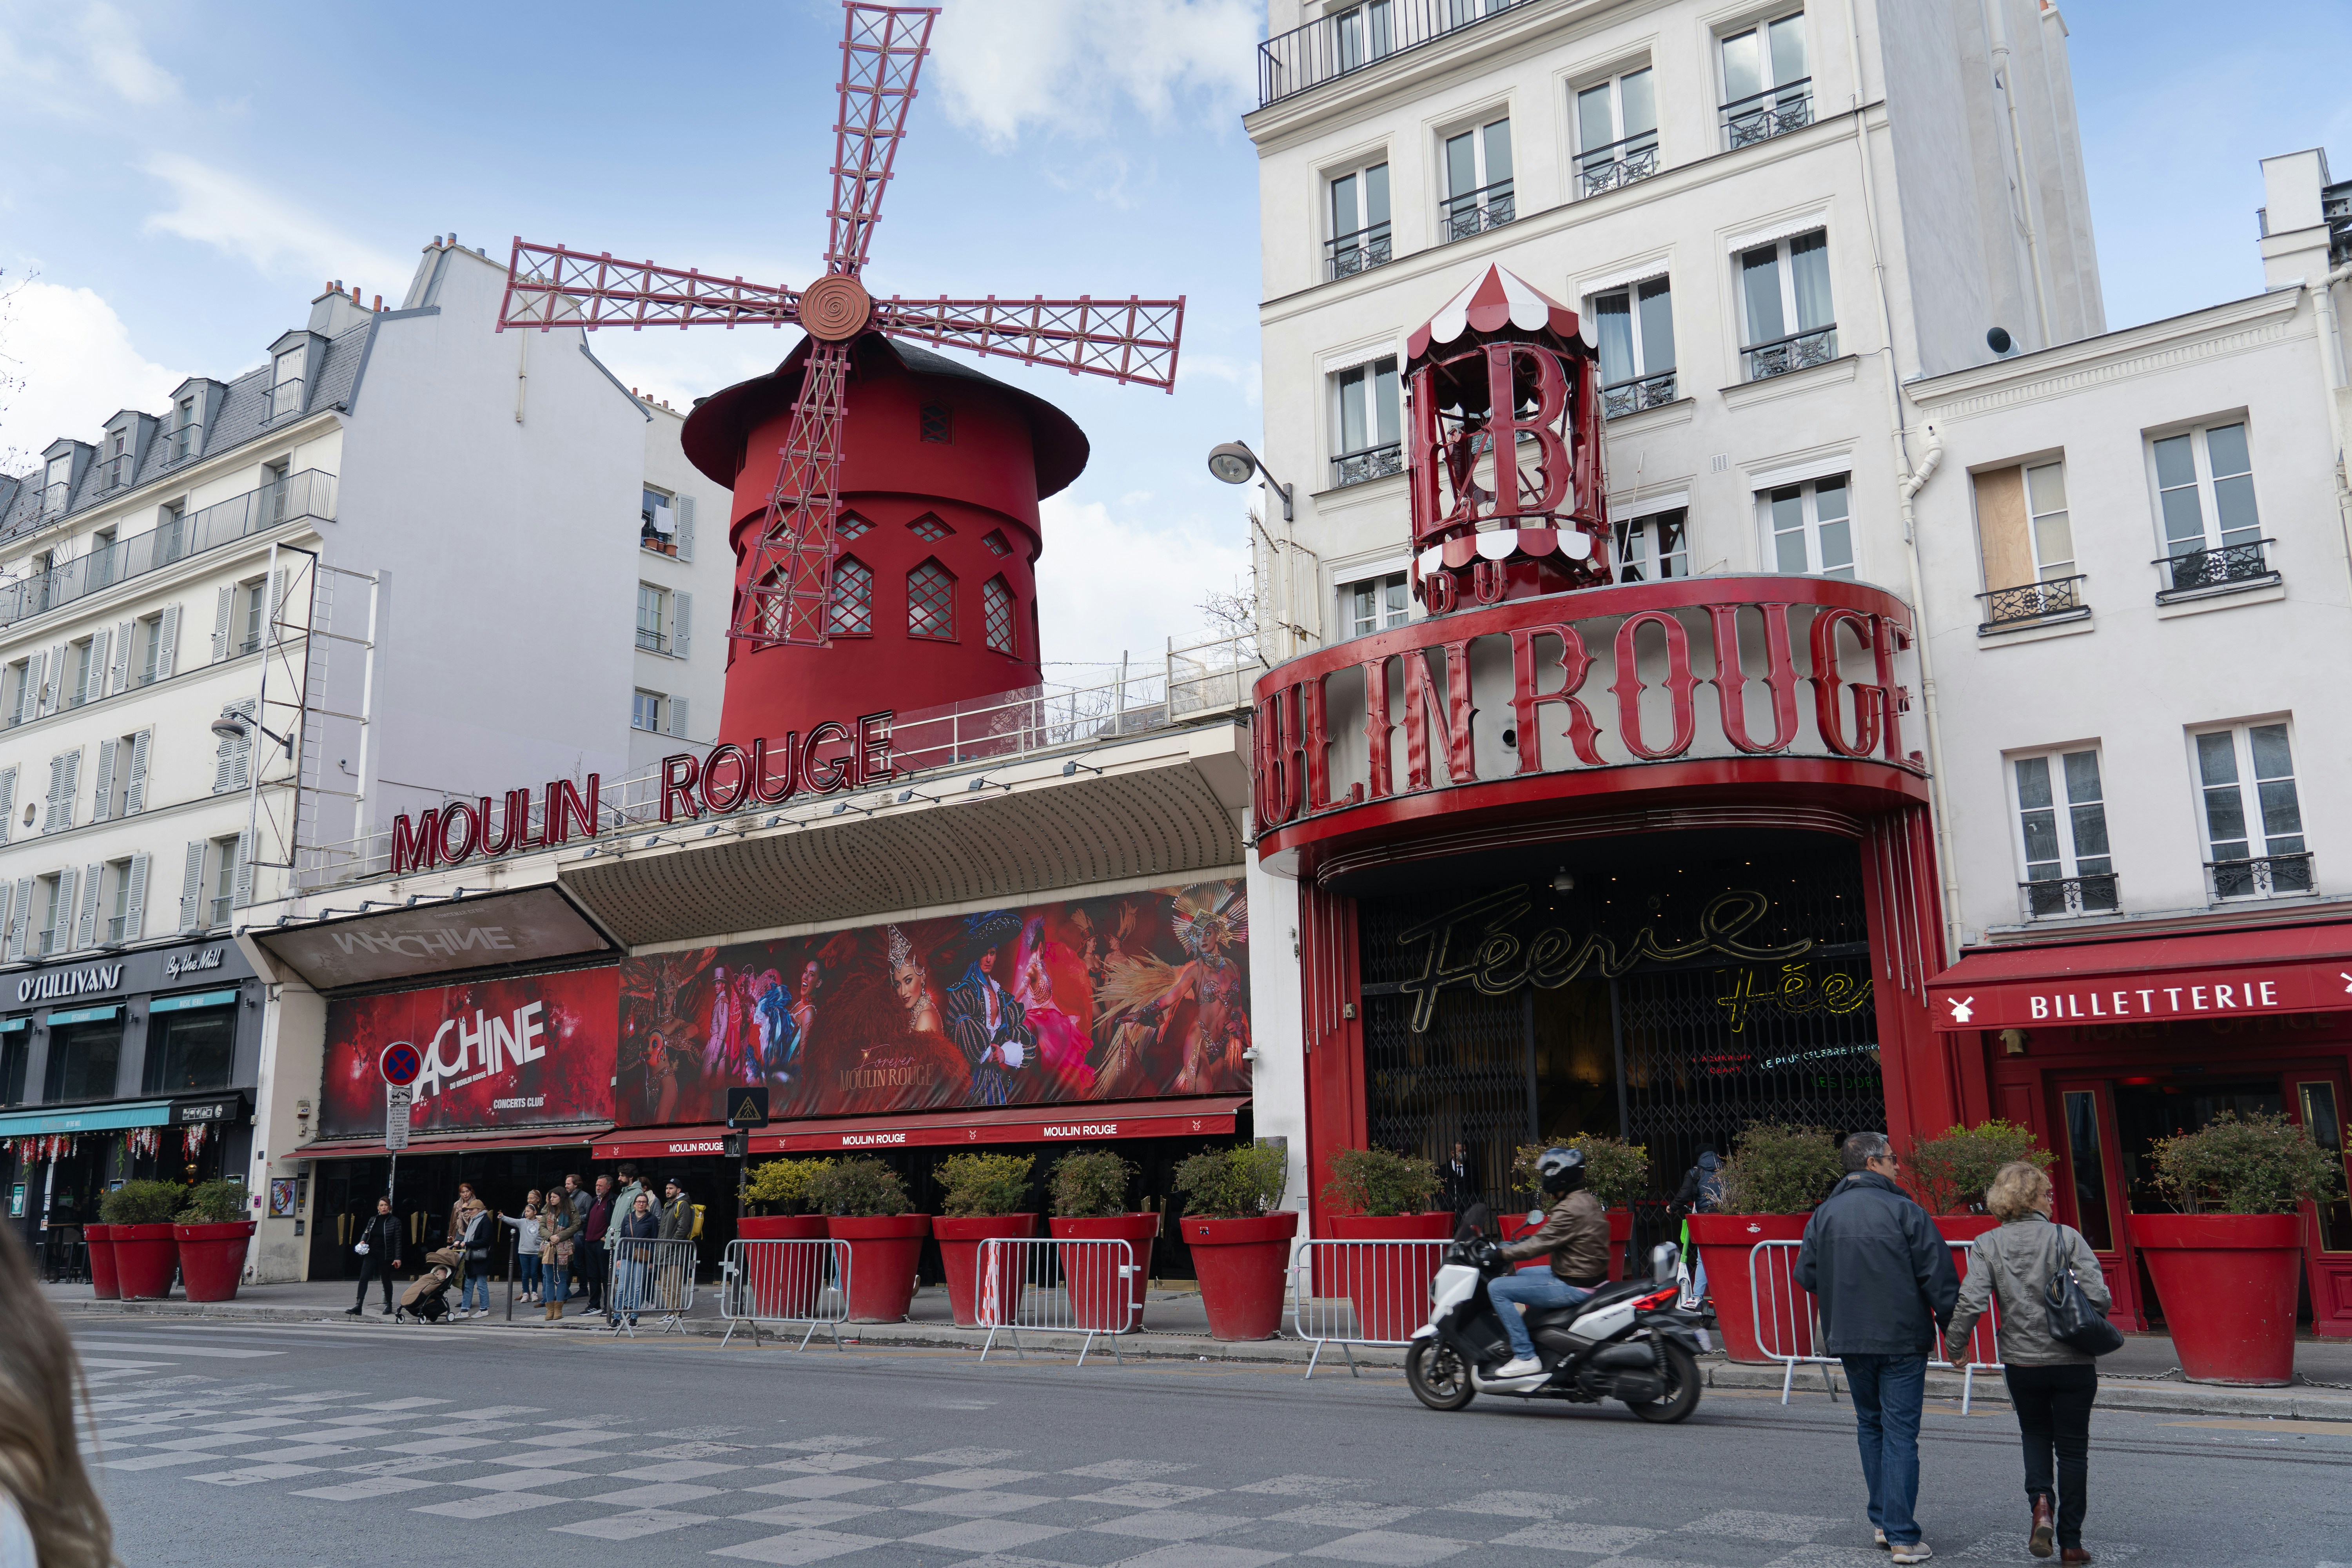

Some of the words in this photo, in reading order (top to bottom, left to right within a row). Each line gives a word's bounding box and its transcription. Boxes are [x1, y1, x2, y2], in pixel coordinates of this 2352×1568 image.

[1425, 559, 1508, 616] DU
[1507, 603, 1927, 775] ROUGE
[390, 772, 601, 875] MOULIN
[660, 709, 898, 825] ROUGE
[165, 955, 180, 980] By
[181, 952, 197, 972] the
[197, 947, 222, 970] Mill
[1397, 884, 1811, 1033] Féerie
[18, 964, 123, 1002] O'SULLIVANS
[179, 999, 191, 1007] MUSIC
[192, 998, 204, 1006] VENUE
[2030, 981, 2278, 1019] BILLETTERIE
[411, 1000, 545, 1105] ACHINE
[853, 1044, 916, 1077] Forever
[456, 1076, 472, 1087] MOULIN
[472, 1071, 486, 1081] ROUGE
[839, 1069, 886, 1092] MOULIN
[888, 1063, 933, 1086] ROUGE
[1810, 1076, 1838, 1088] LES
[494, 1098, 526, 1109] CONCERTS
[527, 1097, 543, 1107] CLUB
[843, 1135, 874, 1145] MOULIN
[876, 1133, 906, 1143] ROUGE
[1044, 1126, 1080, 1136] MOULIN
[1083, 1124, 1117, 1135] ROUGE
[670, 1143, 697, 1152] MOULIN
[699, 1142, 724, 1151] ROUGE
